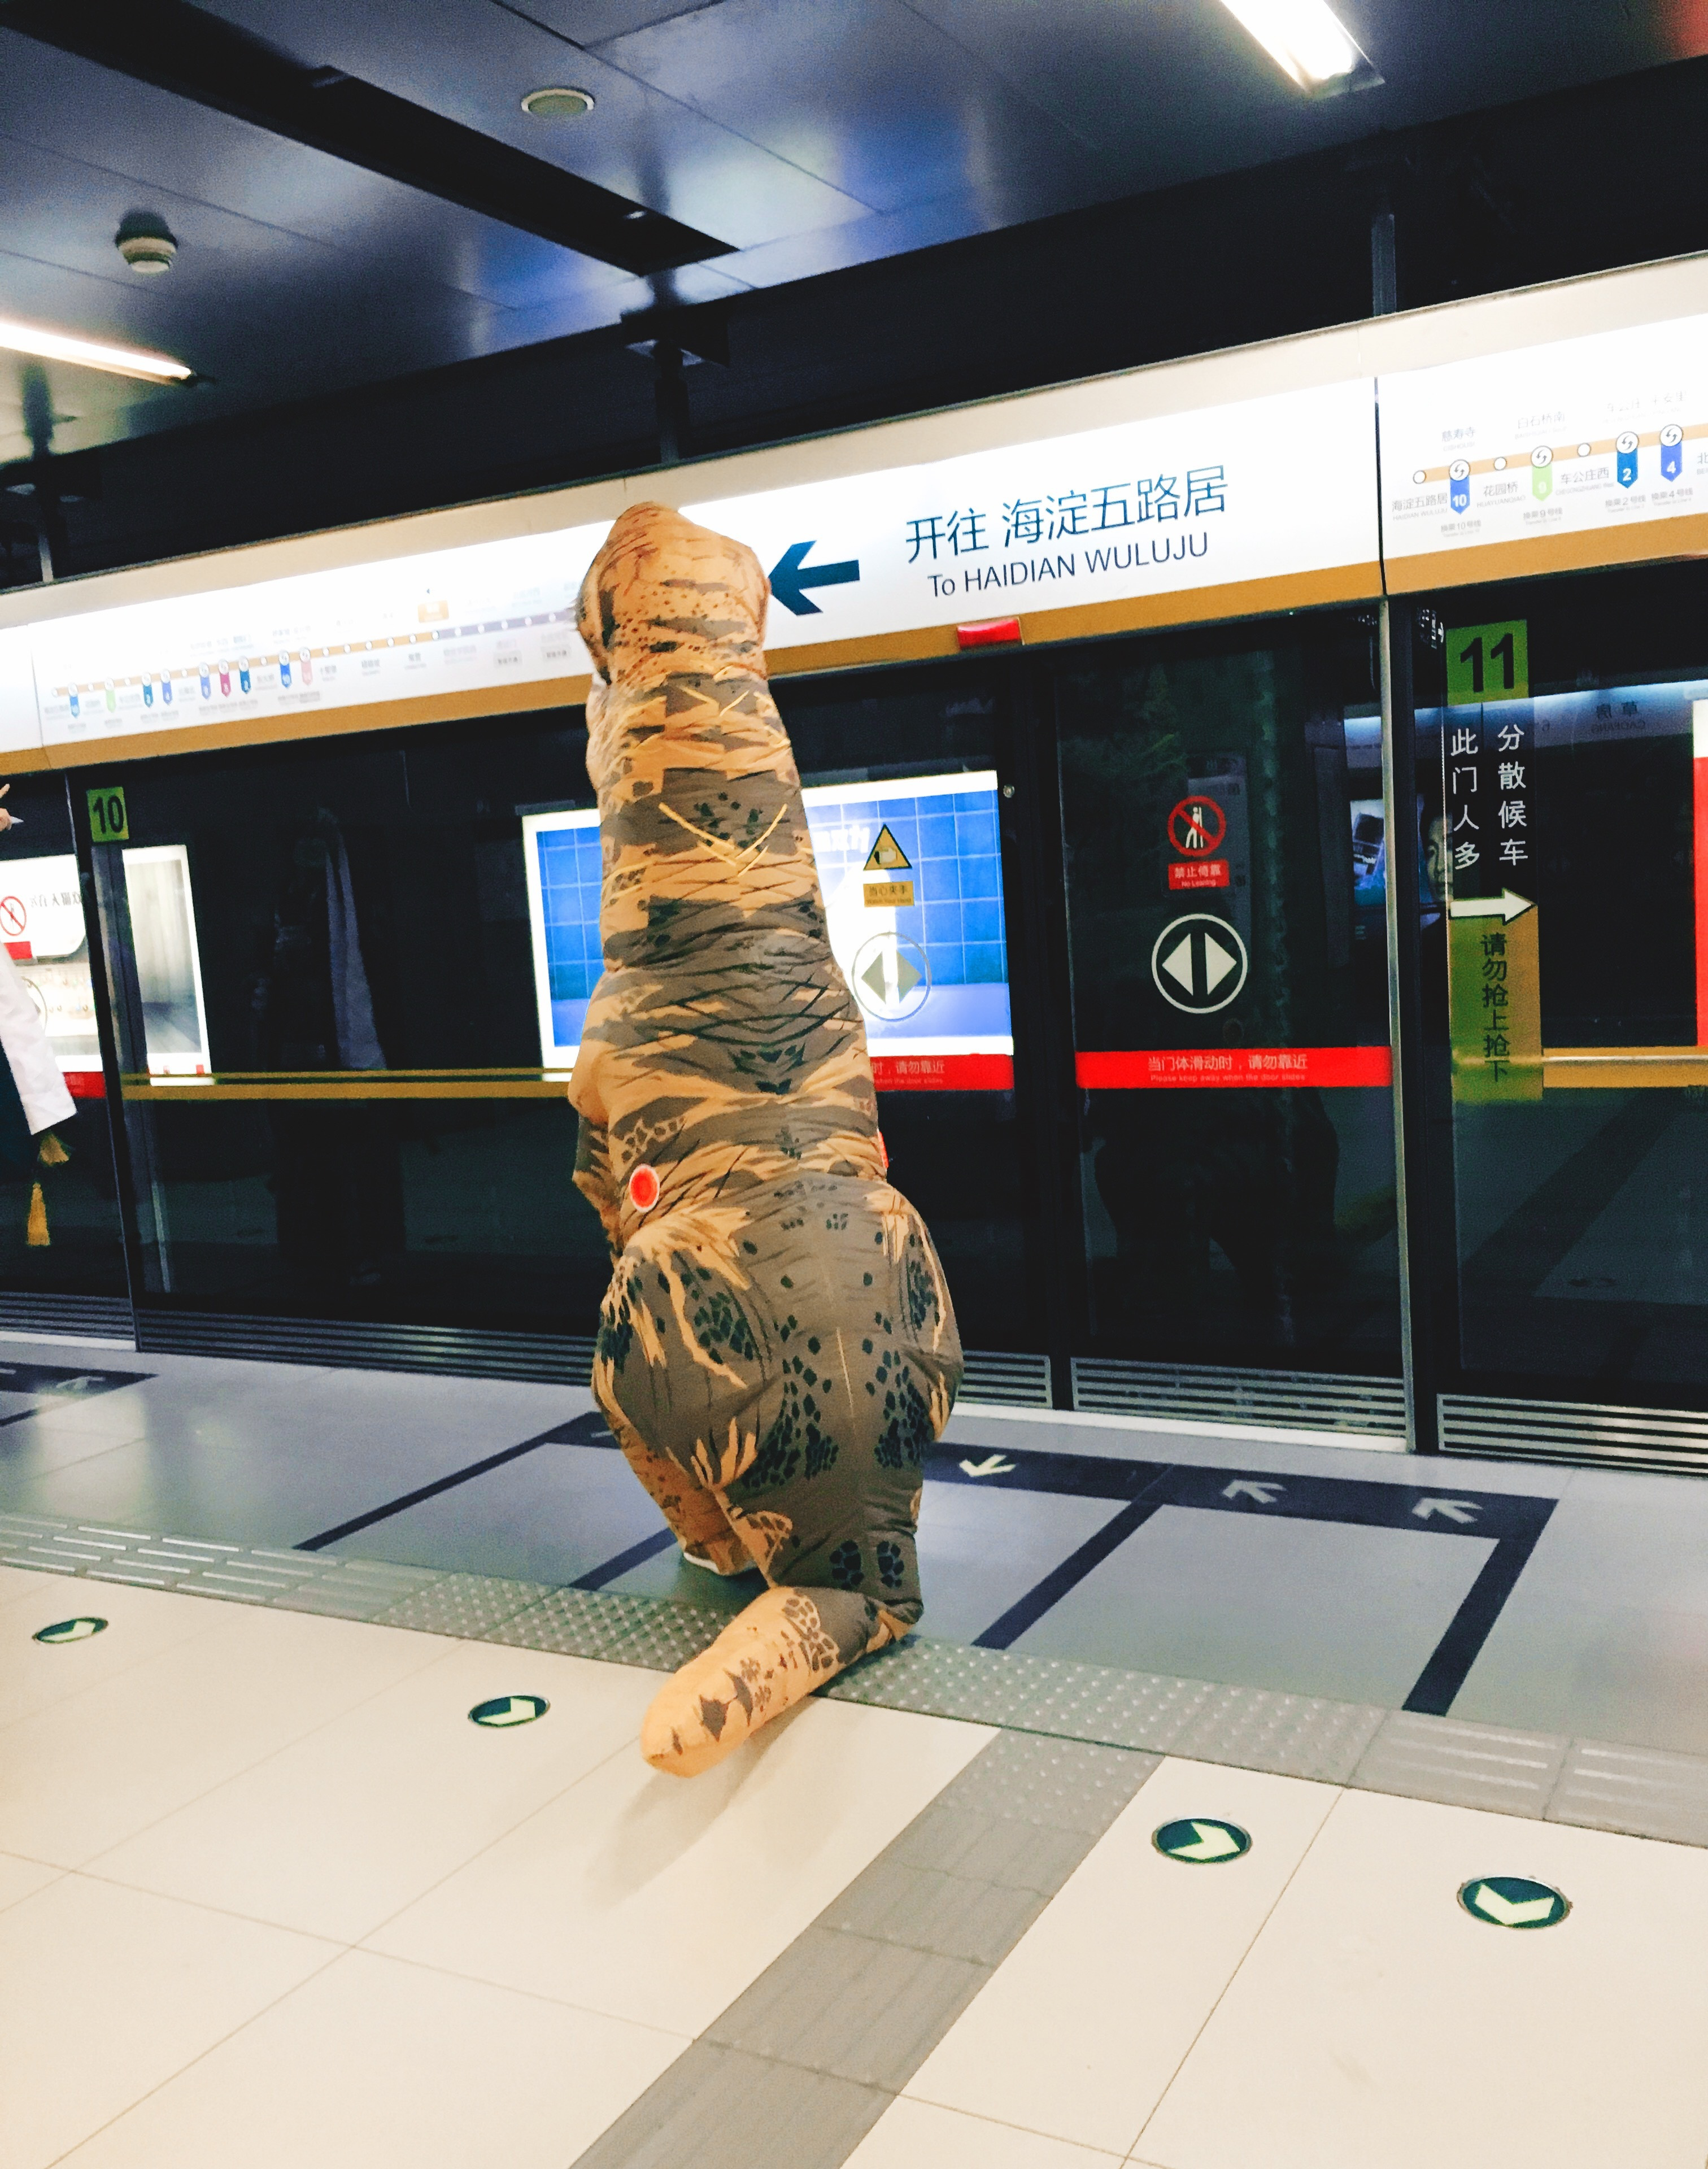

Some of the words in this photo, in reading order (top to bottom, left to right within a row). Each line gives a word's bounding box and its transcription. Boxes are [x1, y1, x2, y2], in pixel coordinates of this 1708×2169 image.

[1560, 467, 1609, 484] 车公庄西
[1623, 468, 1632, 481] 2
[1667, 461, 1676, 474] 4
[1392, 493, 1448, 512] 海淀五路居
[1452, 494, 1467, 508] 10
[1483, 481, 1518, 497] 花园桥
[905, 507, 990, 564] 开往
[1002, 464, 1228, 548] 海淀五路居
[927, 573, 956, 598] To
[965, 552, 1077, 593] HAIDIAN
[1084, 532, 1210, 574] WULUJU
[1460, 633, 1515, 693] 11
[93, 794, 124, 834] 10
[1450, 728, 1480, 870] 此门人多
[1497, 724, 1528, 866] 分散候车
[1480, 932, 1510, 1083] 请勿抢上抢下
